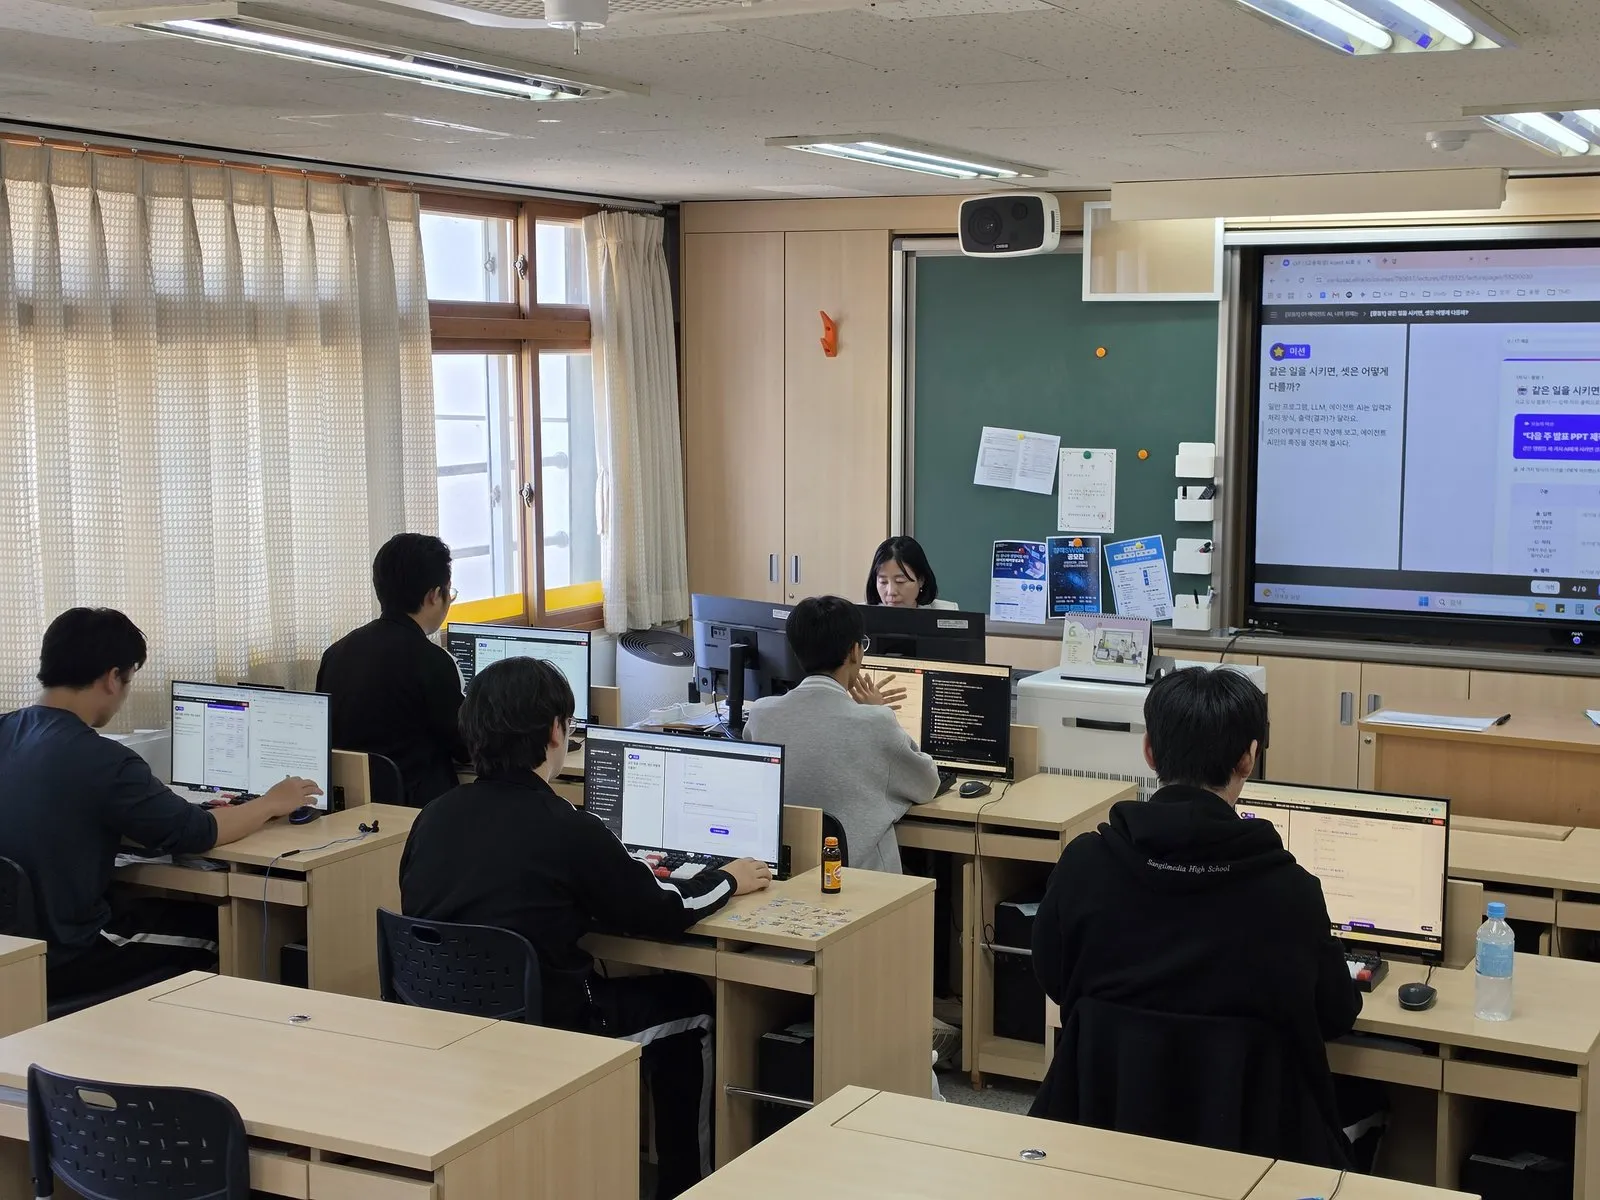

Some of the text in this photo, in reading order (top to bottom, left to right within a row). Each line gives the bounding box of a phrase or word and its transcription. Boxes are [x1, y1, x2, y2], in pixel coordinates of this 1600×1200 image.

[1289, 347, 1306, 357] 미션
[1268, 366, 1389, 378] 같은 일을 시키면, 셋은 어떻게
[1268, 382, 1301, 392] 다를까?
[1532, 386, 1600, 396] 같은 일을 시키면
[1329, 403, 1354, 411] 에이전트
[1543, 432, 1552, 441] 주
[1553, 432, 1569, 441] 발표
[1570, 432, 1589, 441] PPT
[1068, 626, 1077, 637] 6
[1147, 859, 1230, 874] Sangilmedia High School
